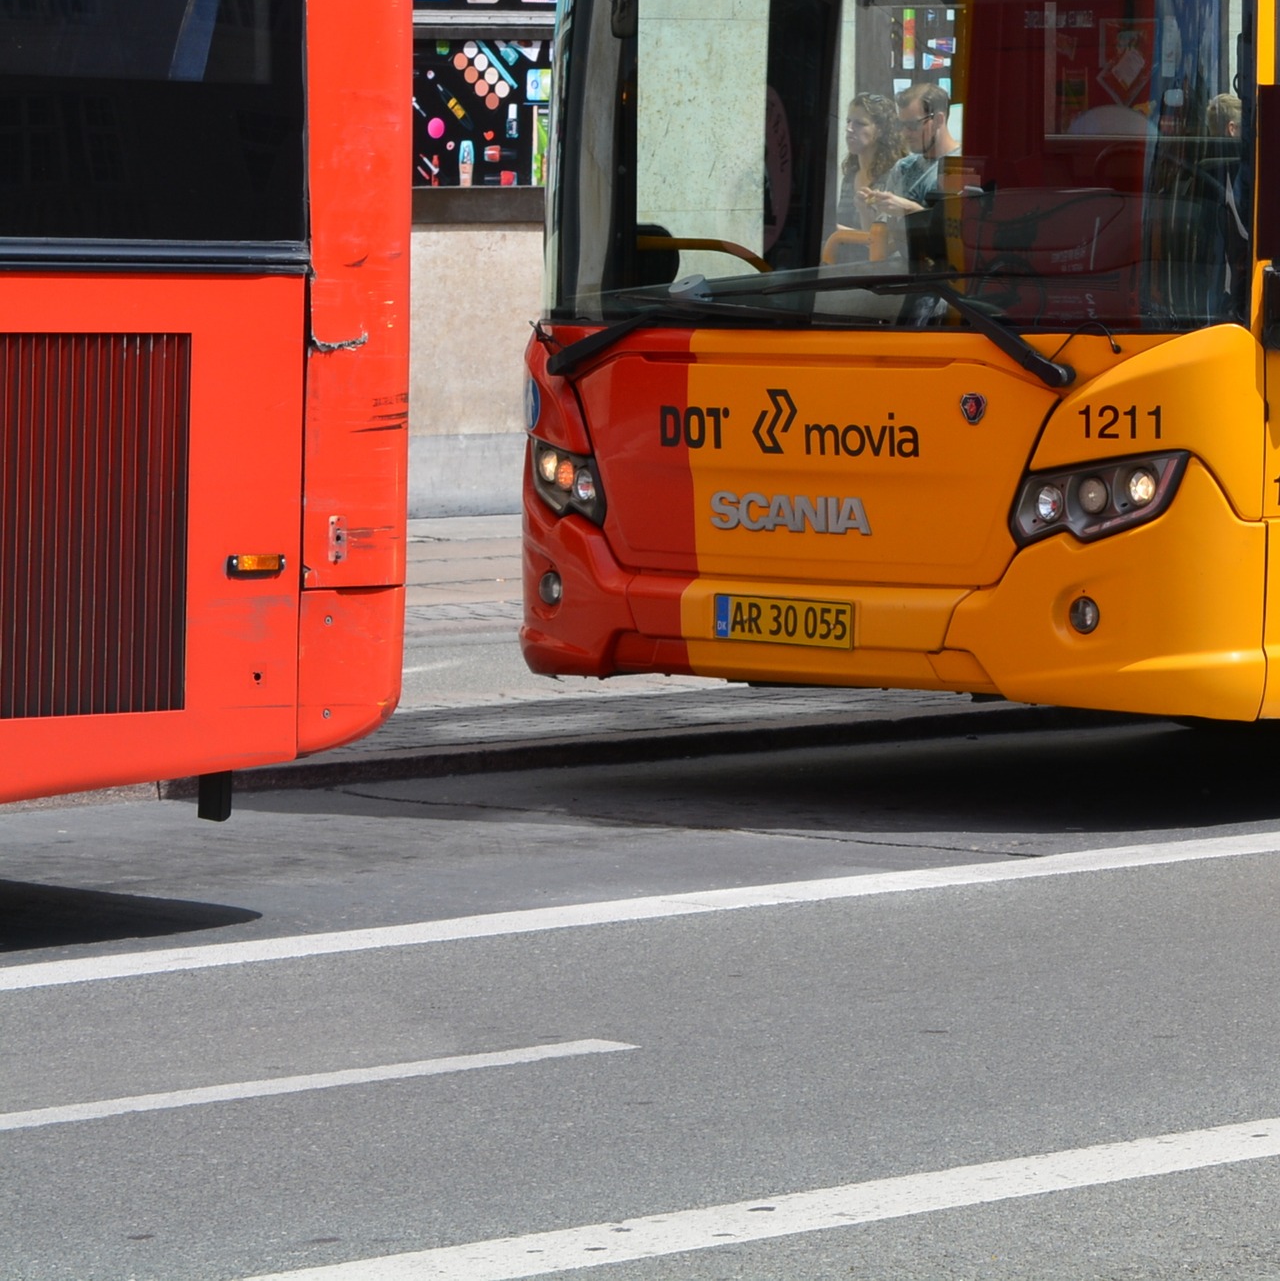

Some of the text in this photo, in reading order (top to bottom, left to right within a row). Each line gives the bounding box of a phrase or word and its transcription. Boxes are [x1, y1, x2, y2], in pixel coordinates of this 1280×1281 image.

[659, 405, 730, 450] DOT
[803, 412, 920, 459] movia
[1078, 404, 1163, 440] 1211
[711, 490, 872, 536] SCANIA
[717, 620, 727, 630] DK
[731, 601, 847, 641] AR 30 055
